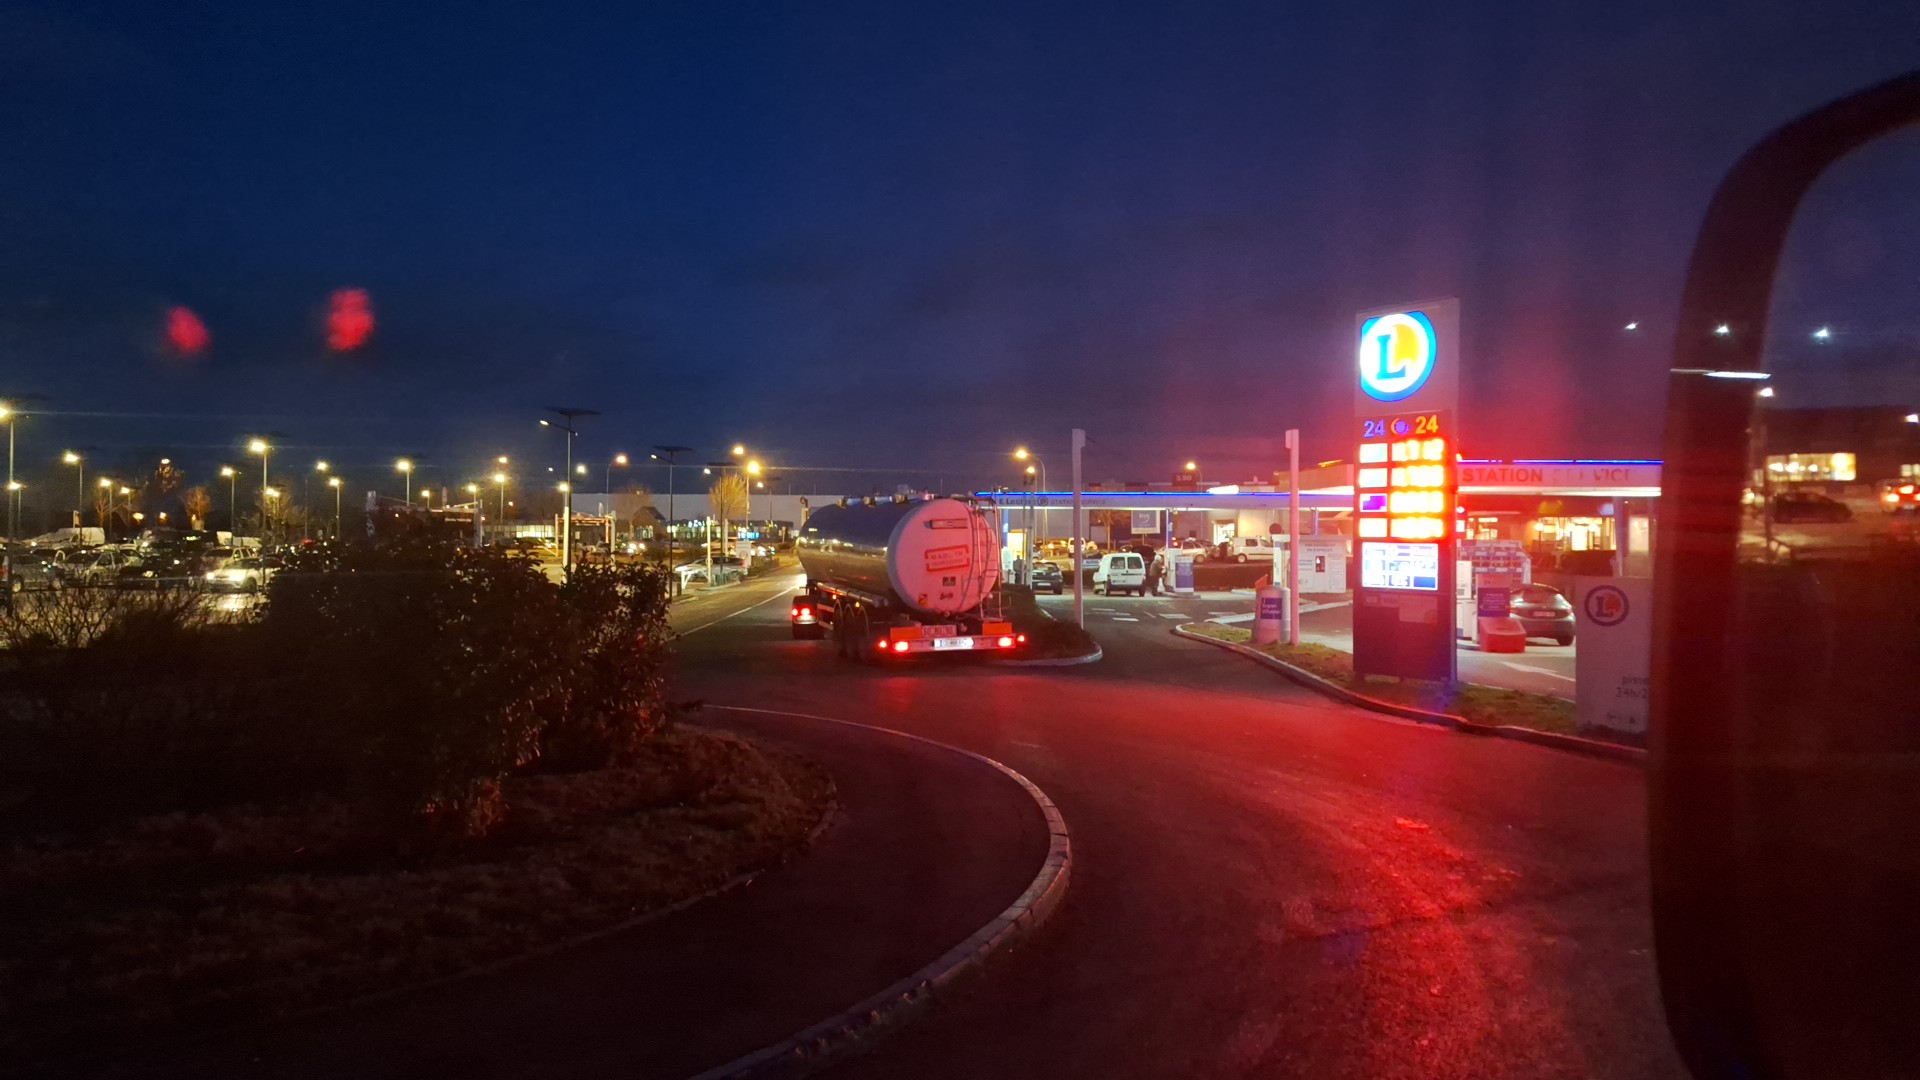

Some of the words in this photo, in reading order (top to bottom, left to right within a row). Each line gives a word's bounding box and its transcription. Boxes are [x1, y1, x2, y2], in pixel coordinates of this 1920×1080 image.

[1363, 419, 1386, 438] 24
[1415, 414, 1439, 435] 24
[1462, 467, 1543, 482] STATION
[1615, 686, 1648, 699] 24h/2
